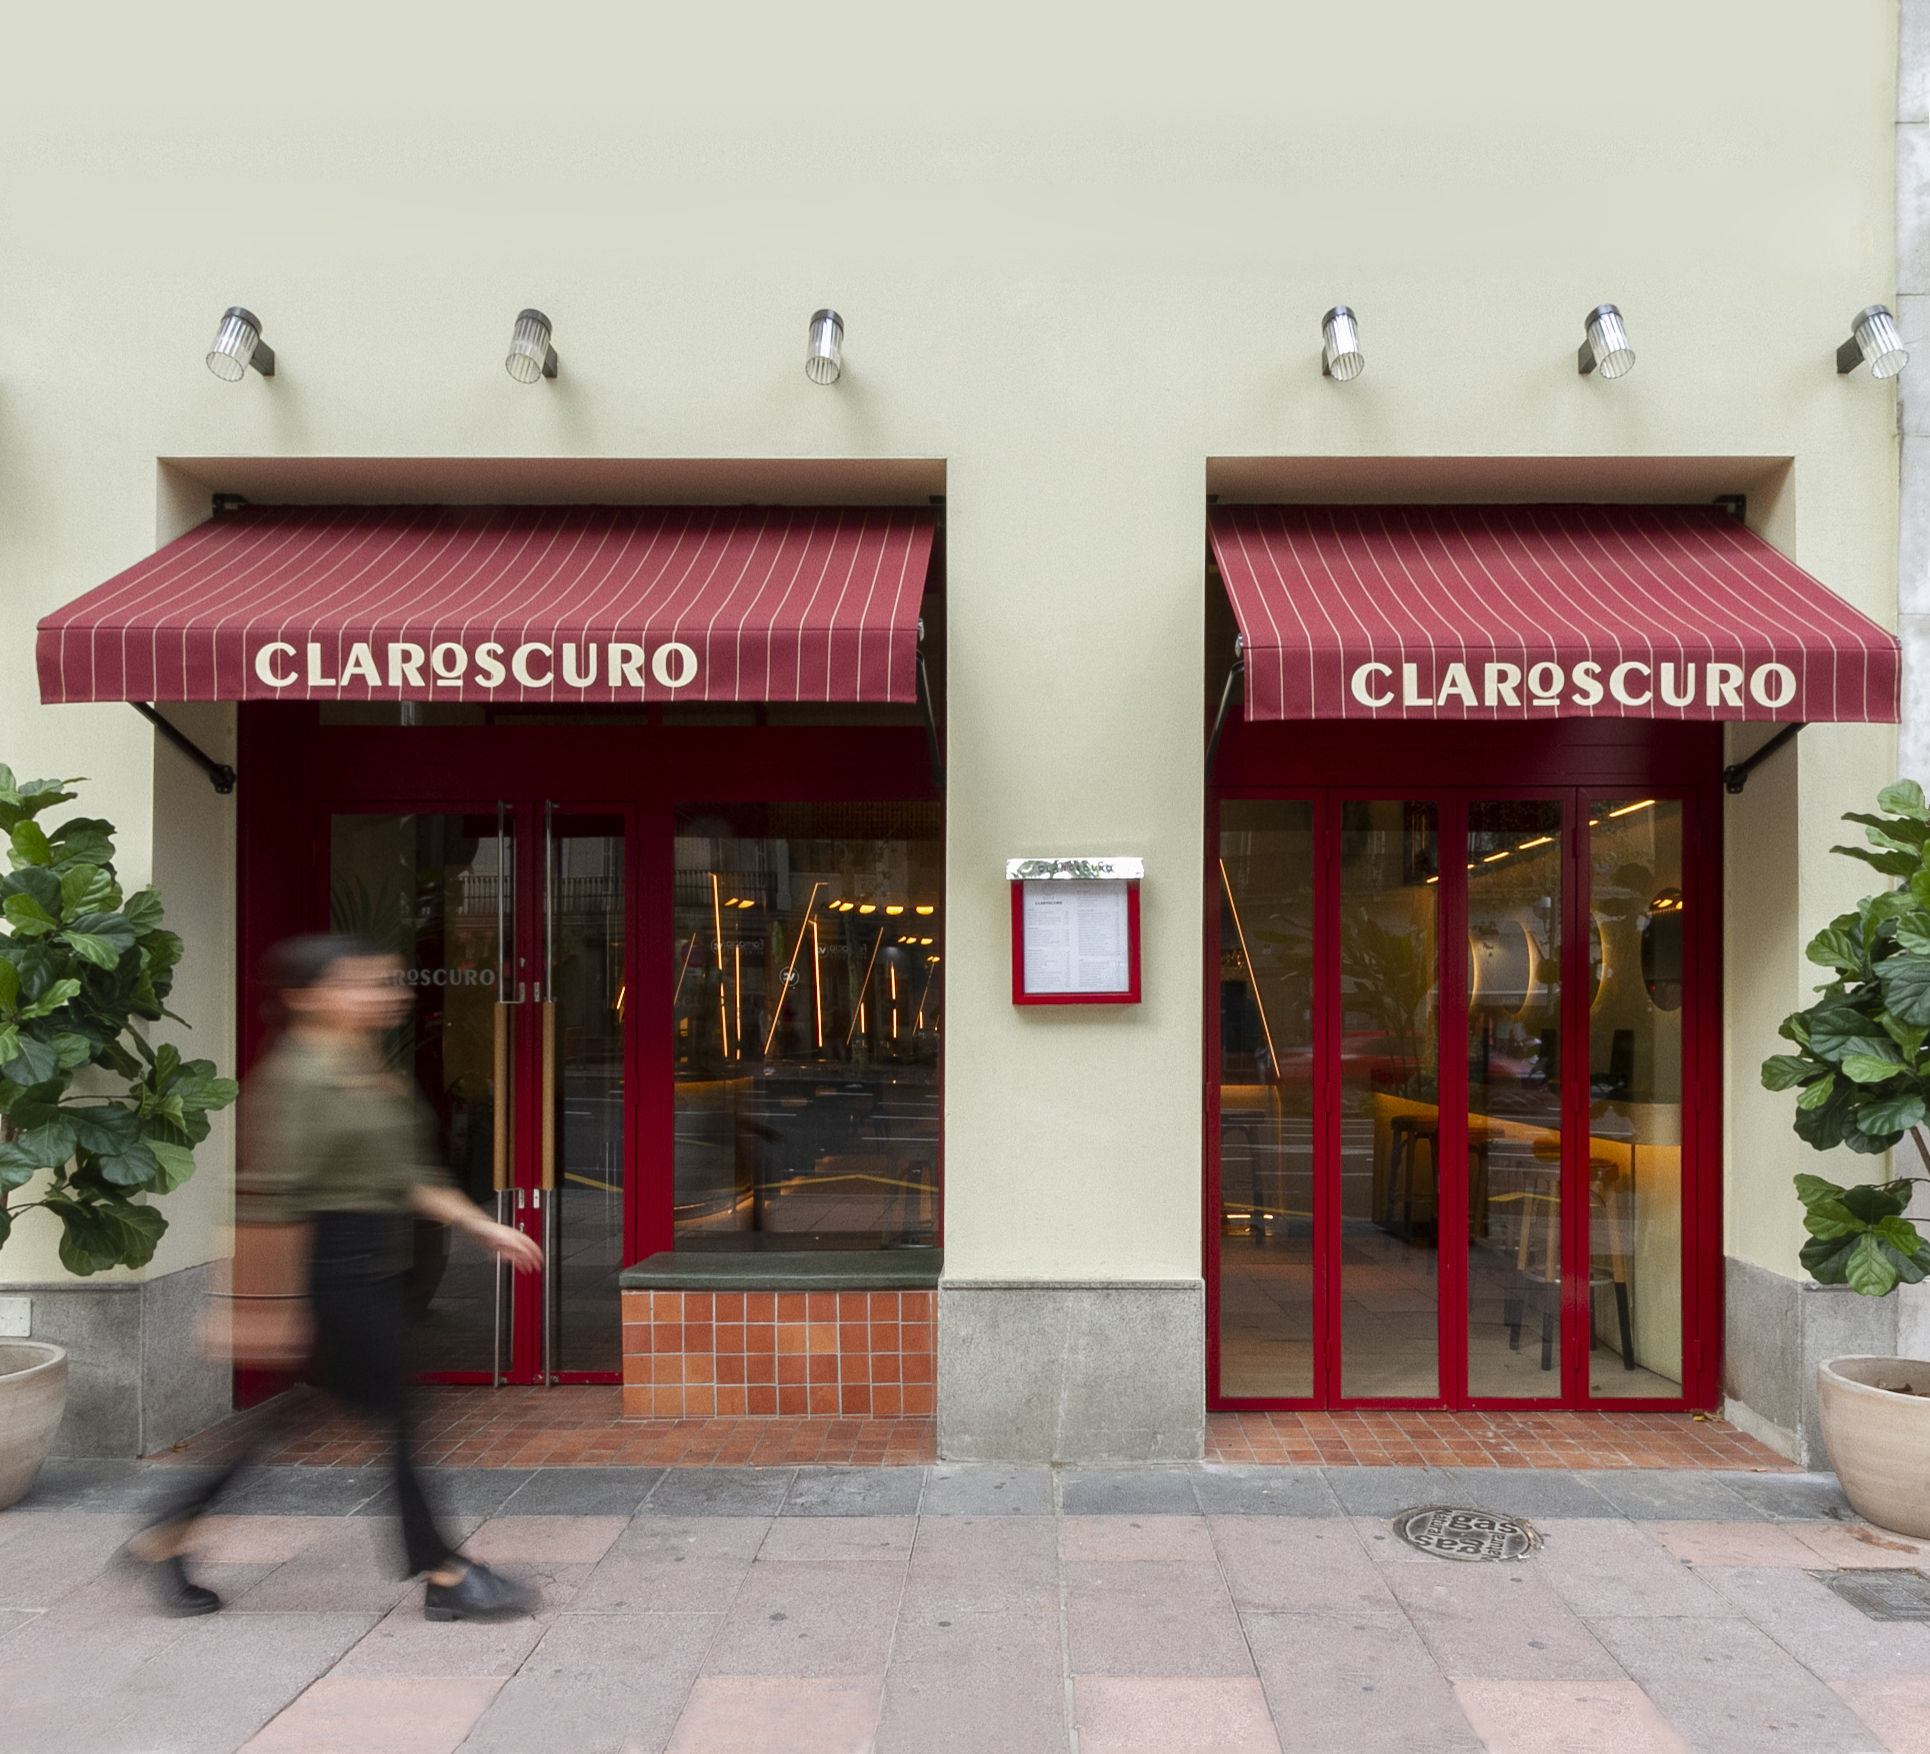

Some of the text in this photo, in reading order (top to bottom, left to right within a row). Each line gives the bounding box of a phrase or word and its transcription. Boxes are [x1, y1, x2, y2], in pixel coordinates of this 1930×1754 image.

[255, 642, 698, 687] CLAROSCURO
[1351, 661, 1797, 707] CLAROSCURO
[391, 968, 496, 987] ROSCURO
[1448, 1514, 1519, 1534] gas
[1414, 1534, 1484, 1554] gas
